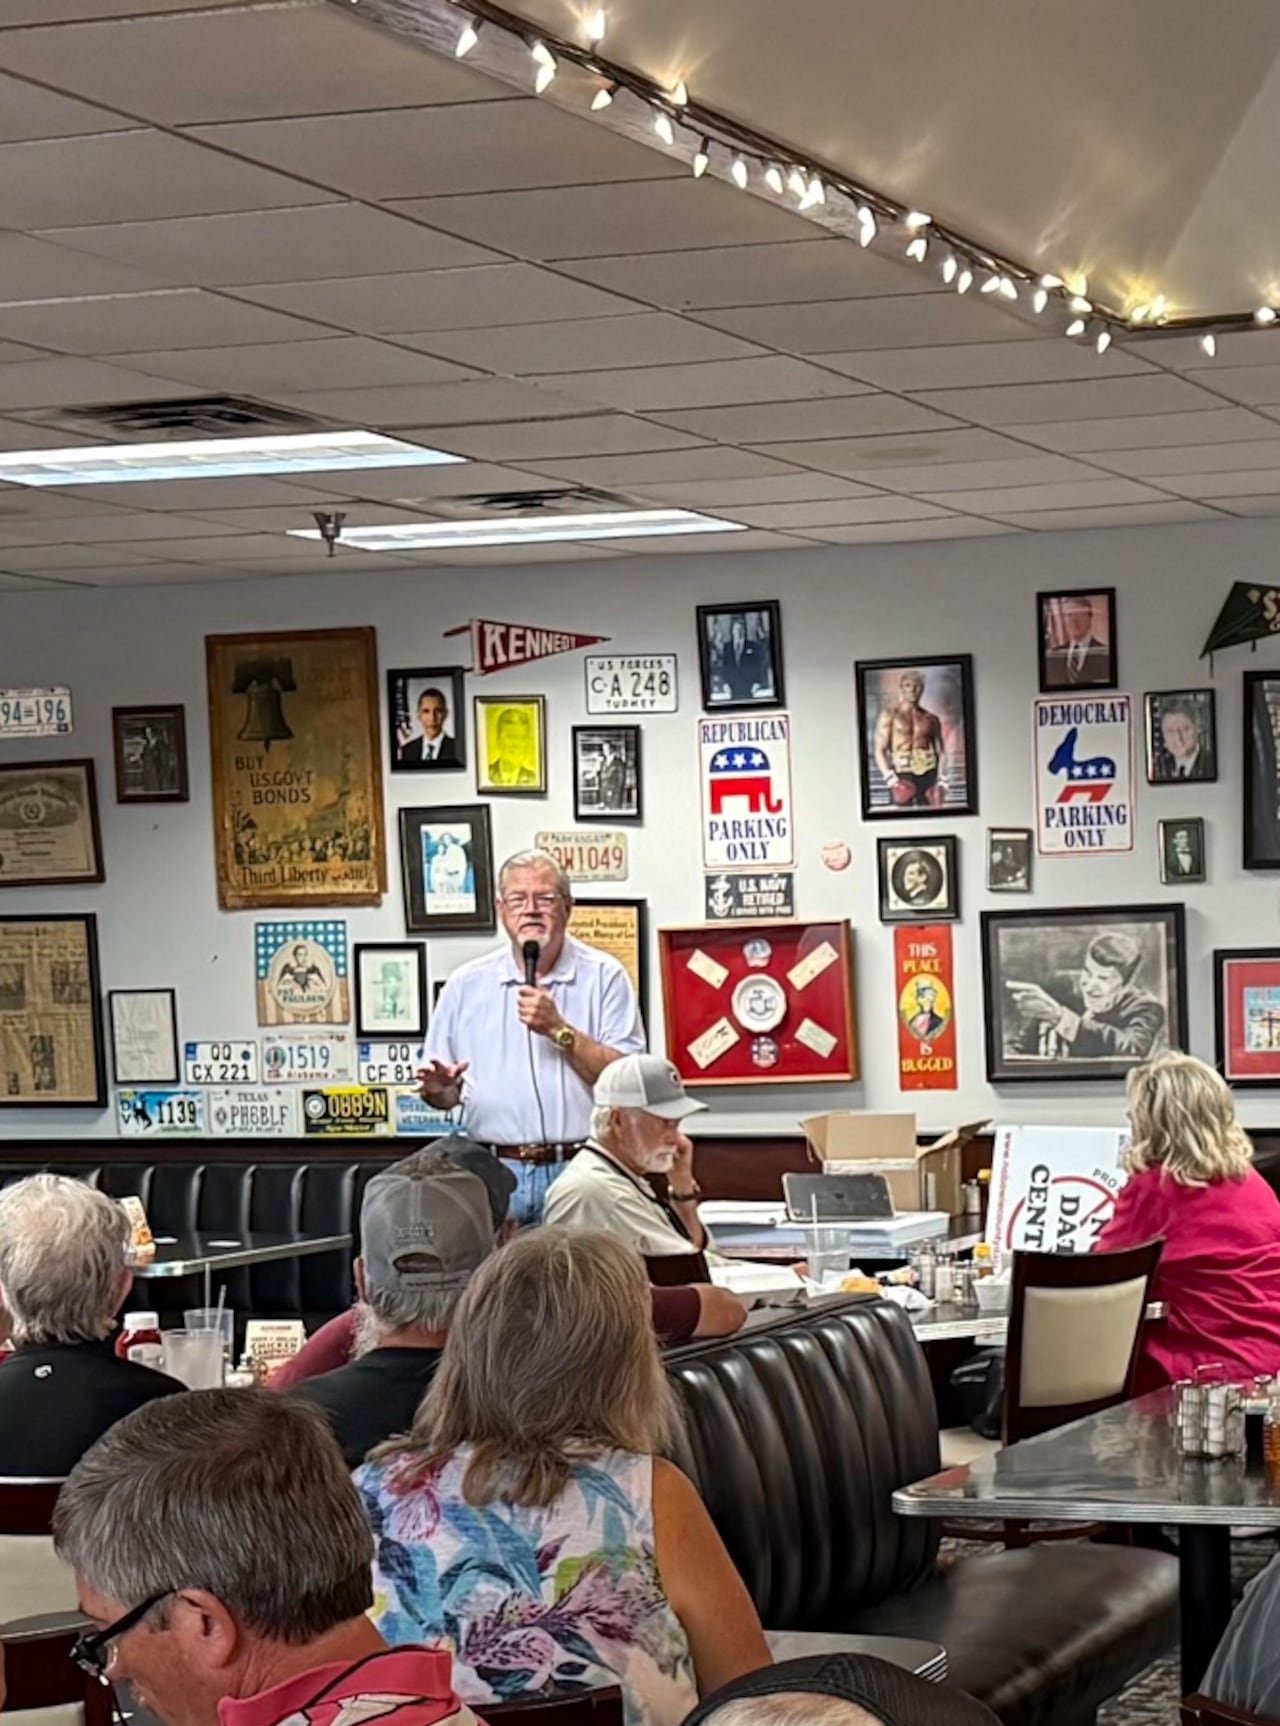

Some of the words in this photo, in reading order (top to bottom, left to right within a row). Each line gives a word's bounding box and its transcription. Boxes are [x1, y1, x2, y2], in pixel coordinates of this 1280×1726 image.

[483, 624, 576, 667] KENNEDY
[620, 660, 664, 670] FORCES
[630, 671, 670, 698] 248
[1038, 701, 1129, 727] DEMOCRAT
[701, 719, 788, 744] REPUBLICAN
[235, 756, 264, 771] BUY
[253, 787, 312, 806] BONDS
[1044, 804, 1127, 829] PARKING
[708, 817, 787, 841] PARKING
[1064, 829, 1106, 848] ONLY
[726, 841, 770, 862] ONLY
[241, 866, 277, 886] Third
[280, 865, 328, 885] Liberty
[760, 878, 787, 892] NAVY
[908, 942, 937, 958] THIS
[902, 959, 942, 973] PLACE
[210, 1044, 232, 1061] QQ
[288, 1045, 330, 1069] 1519
[388, 1044, 410, 1062] QQ
[192, 1064, 213, 1081] CX
[220, 1064, 250, 1081] 221
[366, 1065, 388, 1082] CF
[901, 1056, 953, 1073] BUGGED
[237, 1093, 269, 1103] TEXAS
[157, 1100, 197, 1125] 1139
[1023, 1164, 1051, 1249] CENT
[1054, 1193, 1081, 1253] DAT
